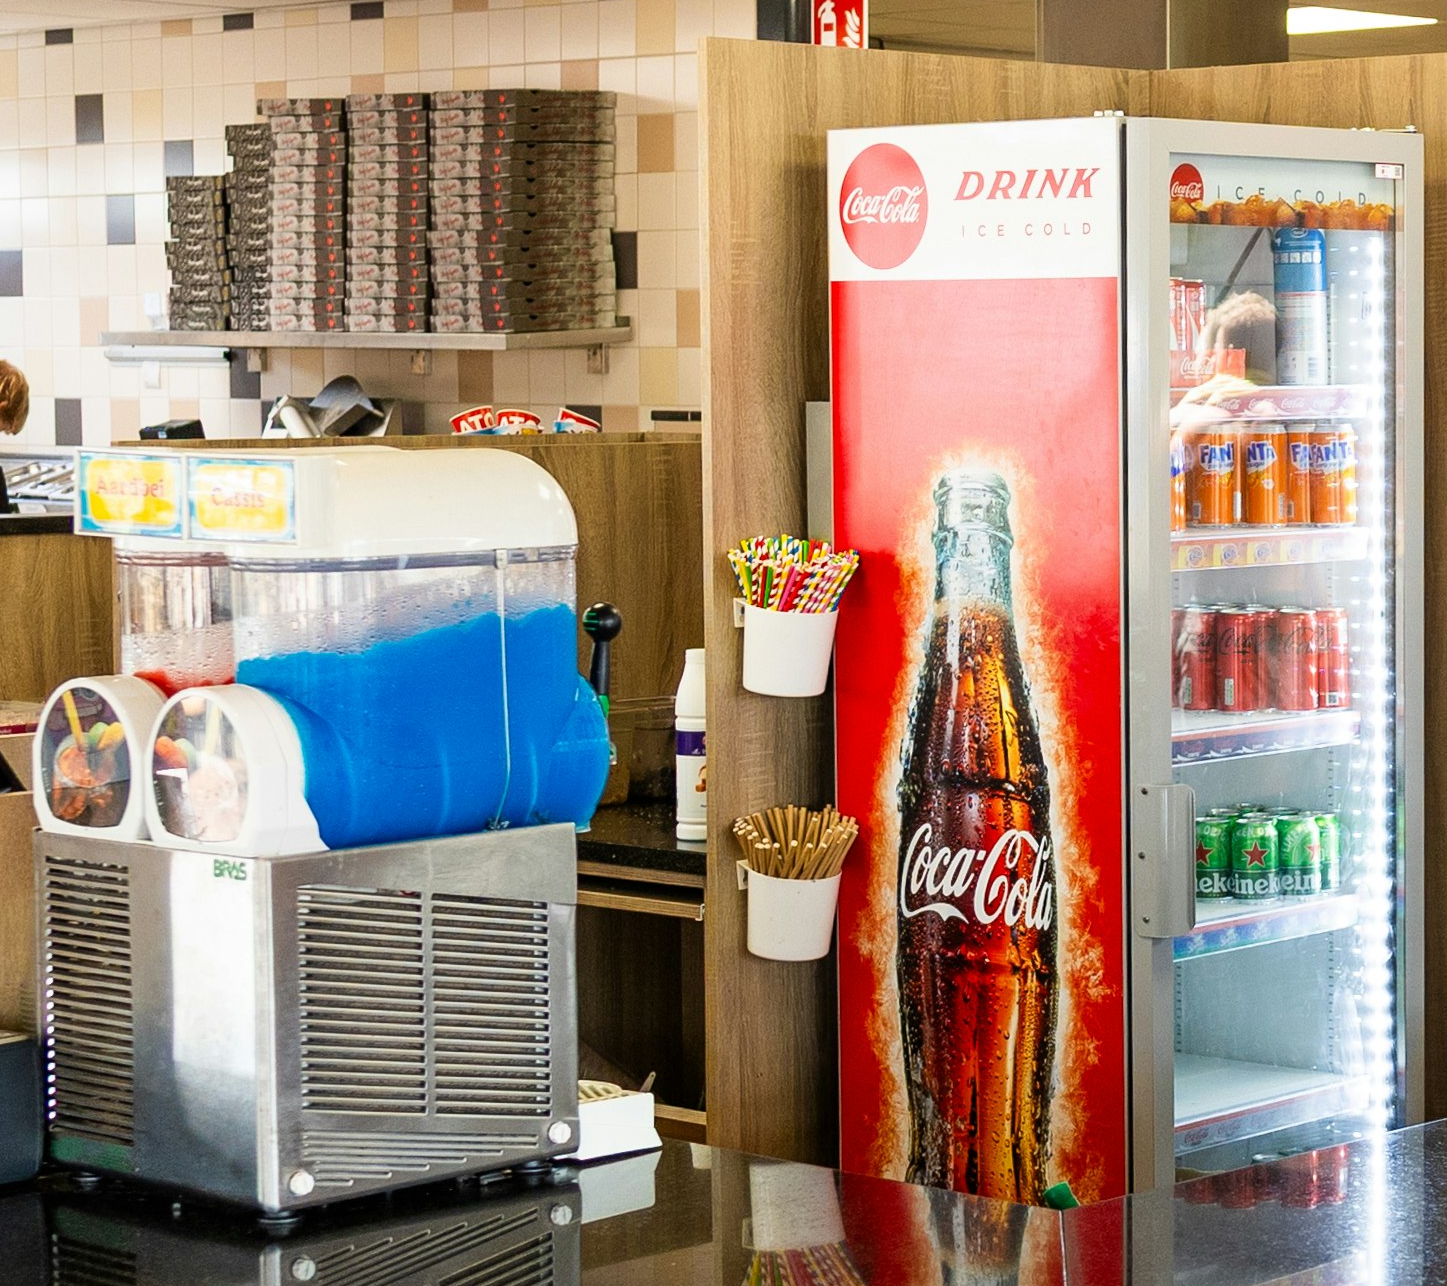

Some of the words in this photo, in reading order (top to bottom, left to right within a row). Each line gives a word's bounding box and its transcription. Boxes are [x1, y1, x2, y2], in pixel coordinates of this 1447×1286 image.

[843, 185, 925, 224] Coca-Cola
[954, 168, 1101, 201] DRINK
[961, 224, 1006, 238] ICE
[1024, 222, 1093, 237] COLD
[96, 476, 165, 498] Aardbei
[211, 487, 266, 509] Cassis
[213, 858, 247, 881] BRAS
[901, 822, 1053, 932] Coca-Cola
